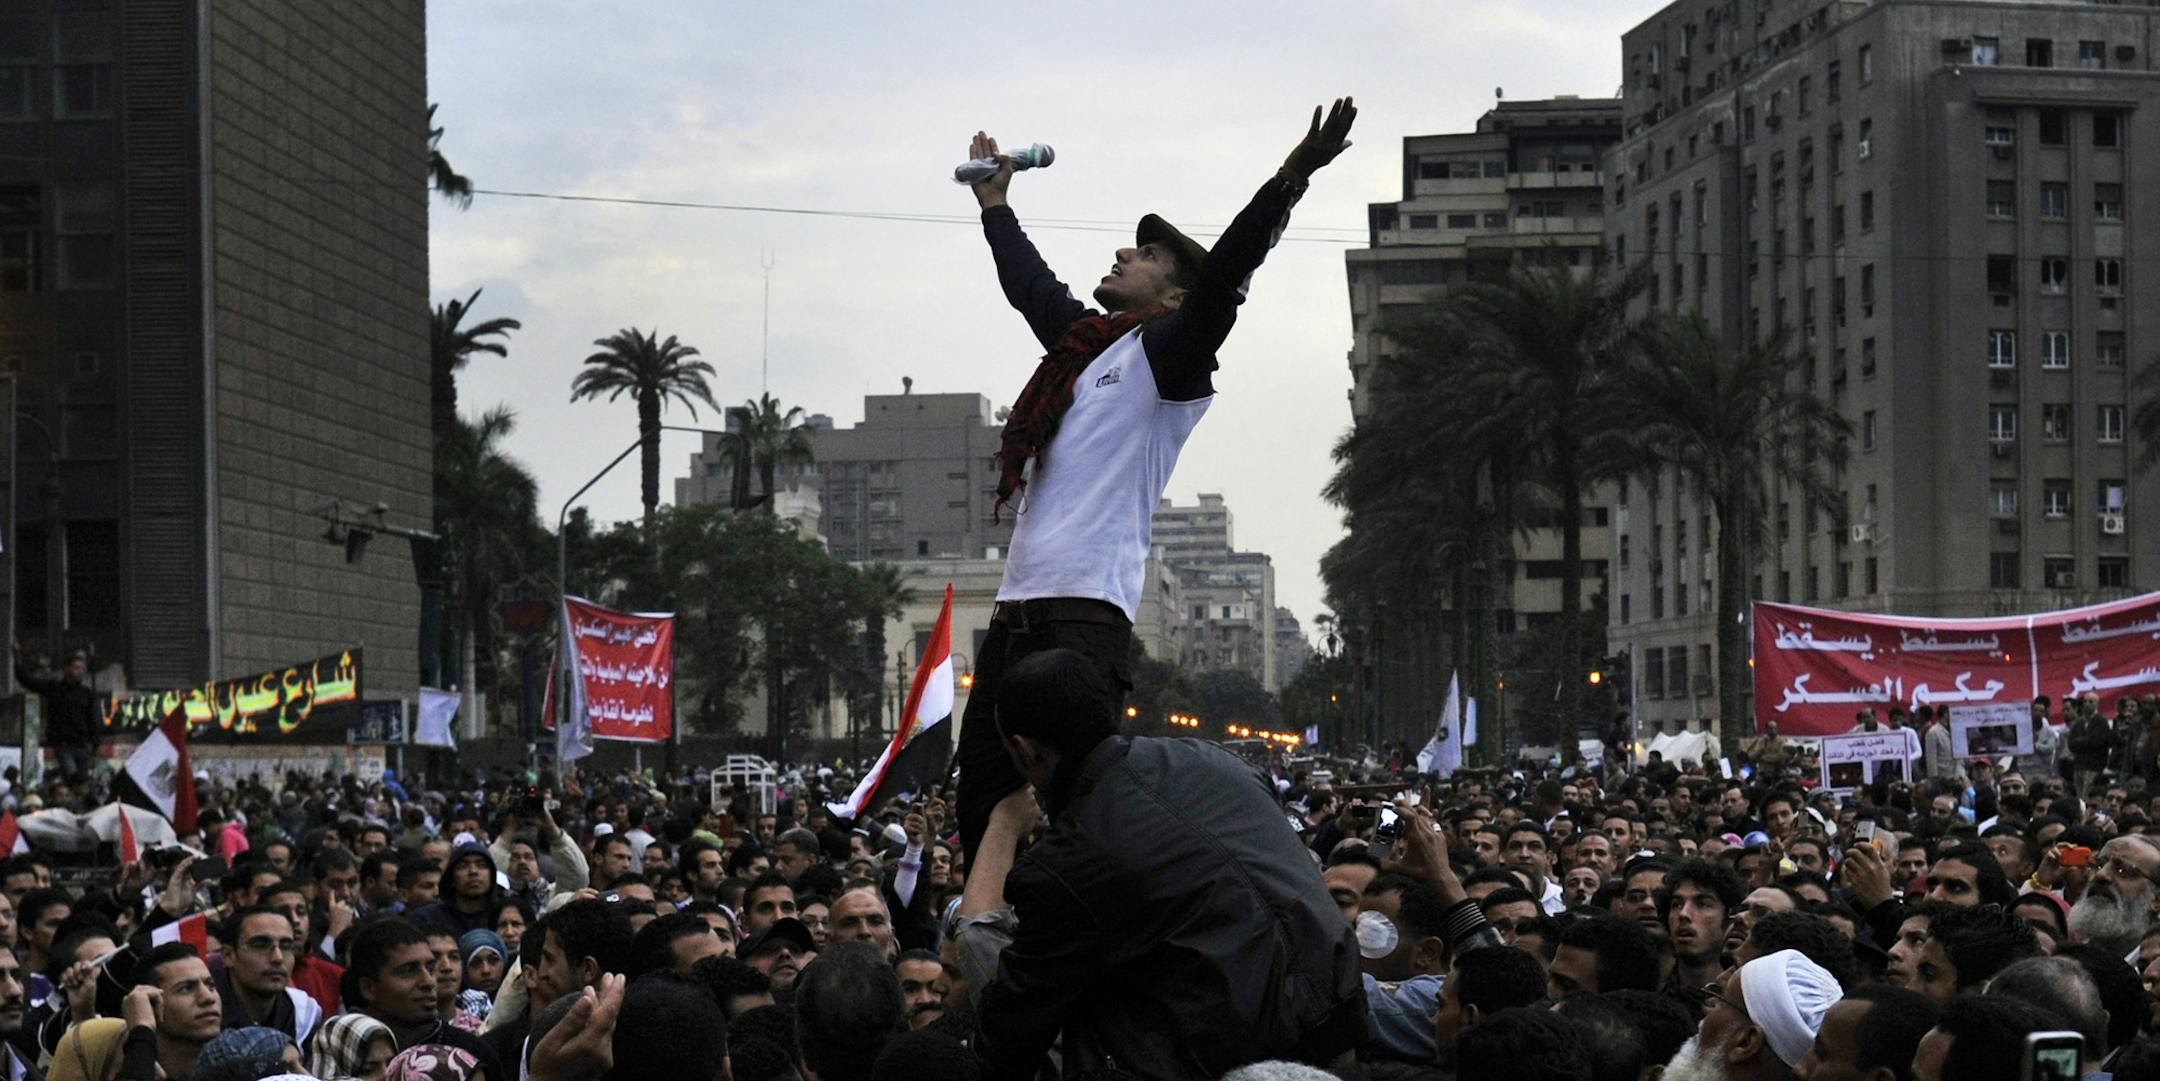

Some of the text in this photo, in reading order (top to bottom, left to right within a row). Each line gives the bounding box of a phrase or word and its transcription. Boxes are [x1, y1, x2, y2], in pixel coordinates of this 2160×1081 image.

[1774, 622, 1873, 660] يسقط
[278, 650, 357, 734] شارع
[1774, 671, 2004, 713] حكم العسكر
